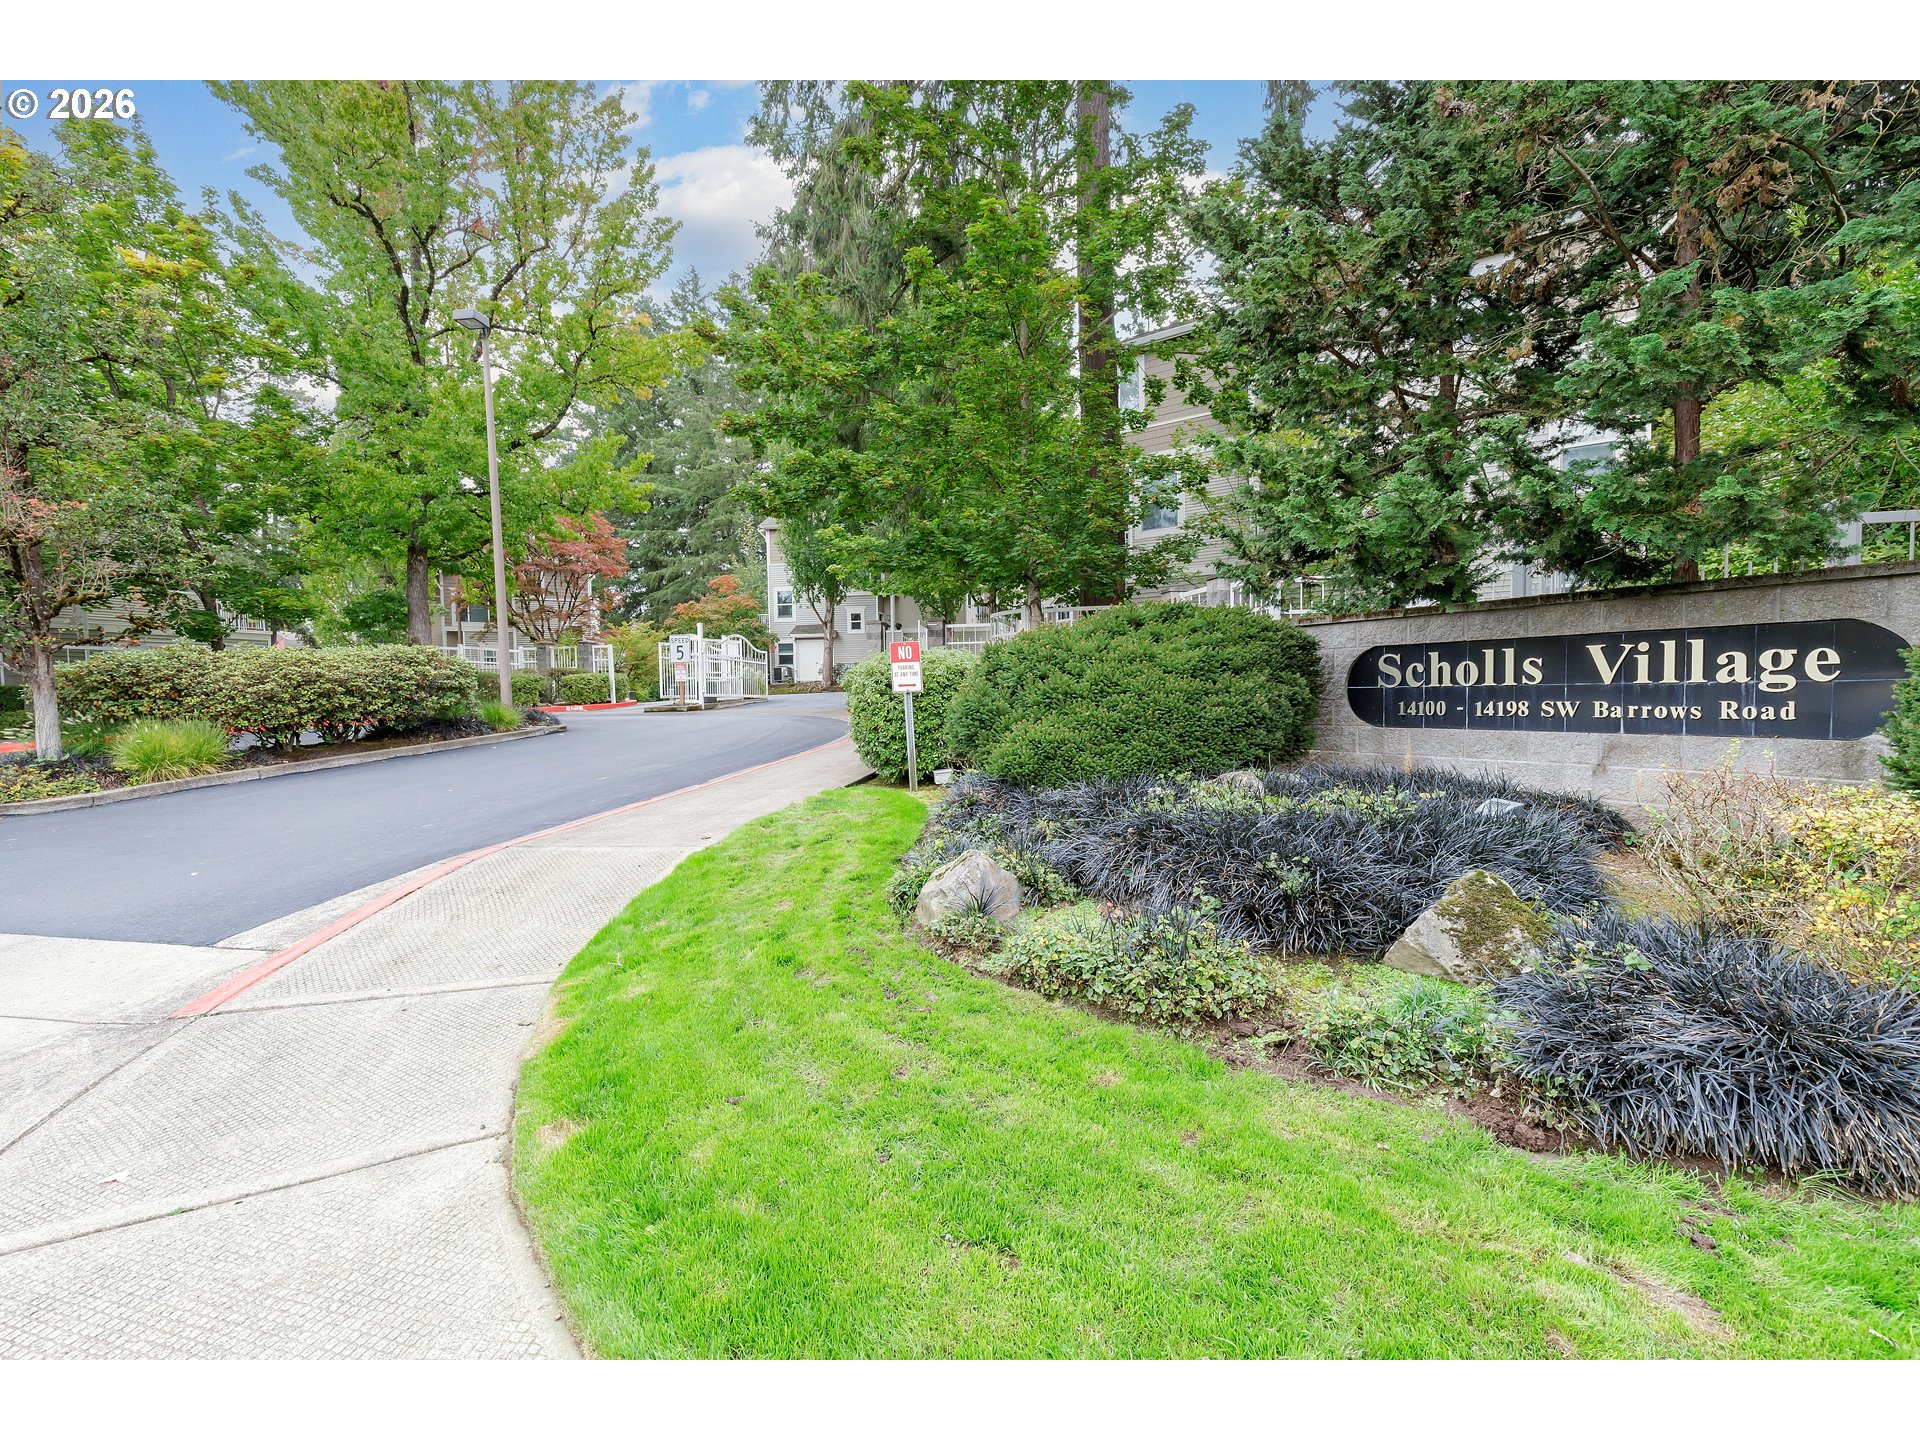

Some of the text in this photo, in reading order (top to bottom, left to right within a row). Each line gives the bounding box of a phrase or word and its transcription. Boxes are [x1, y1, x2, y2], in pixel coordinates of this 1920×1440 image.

[676, 645, 684, 661] 5
[897, 645, 912, 660] NO
[1377, 638, 1841, 693] Scholls Village
[1397, 700, 1447, 717] 14100
[1474, 700, 1530, 718] 14198
[1540, 701, 1580, 718] SW
[1592, 701, 1702, 720] Barrows
[1718, 700, 1797, 721] Road
